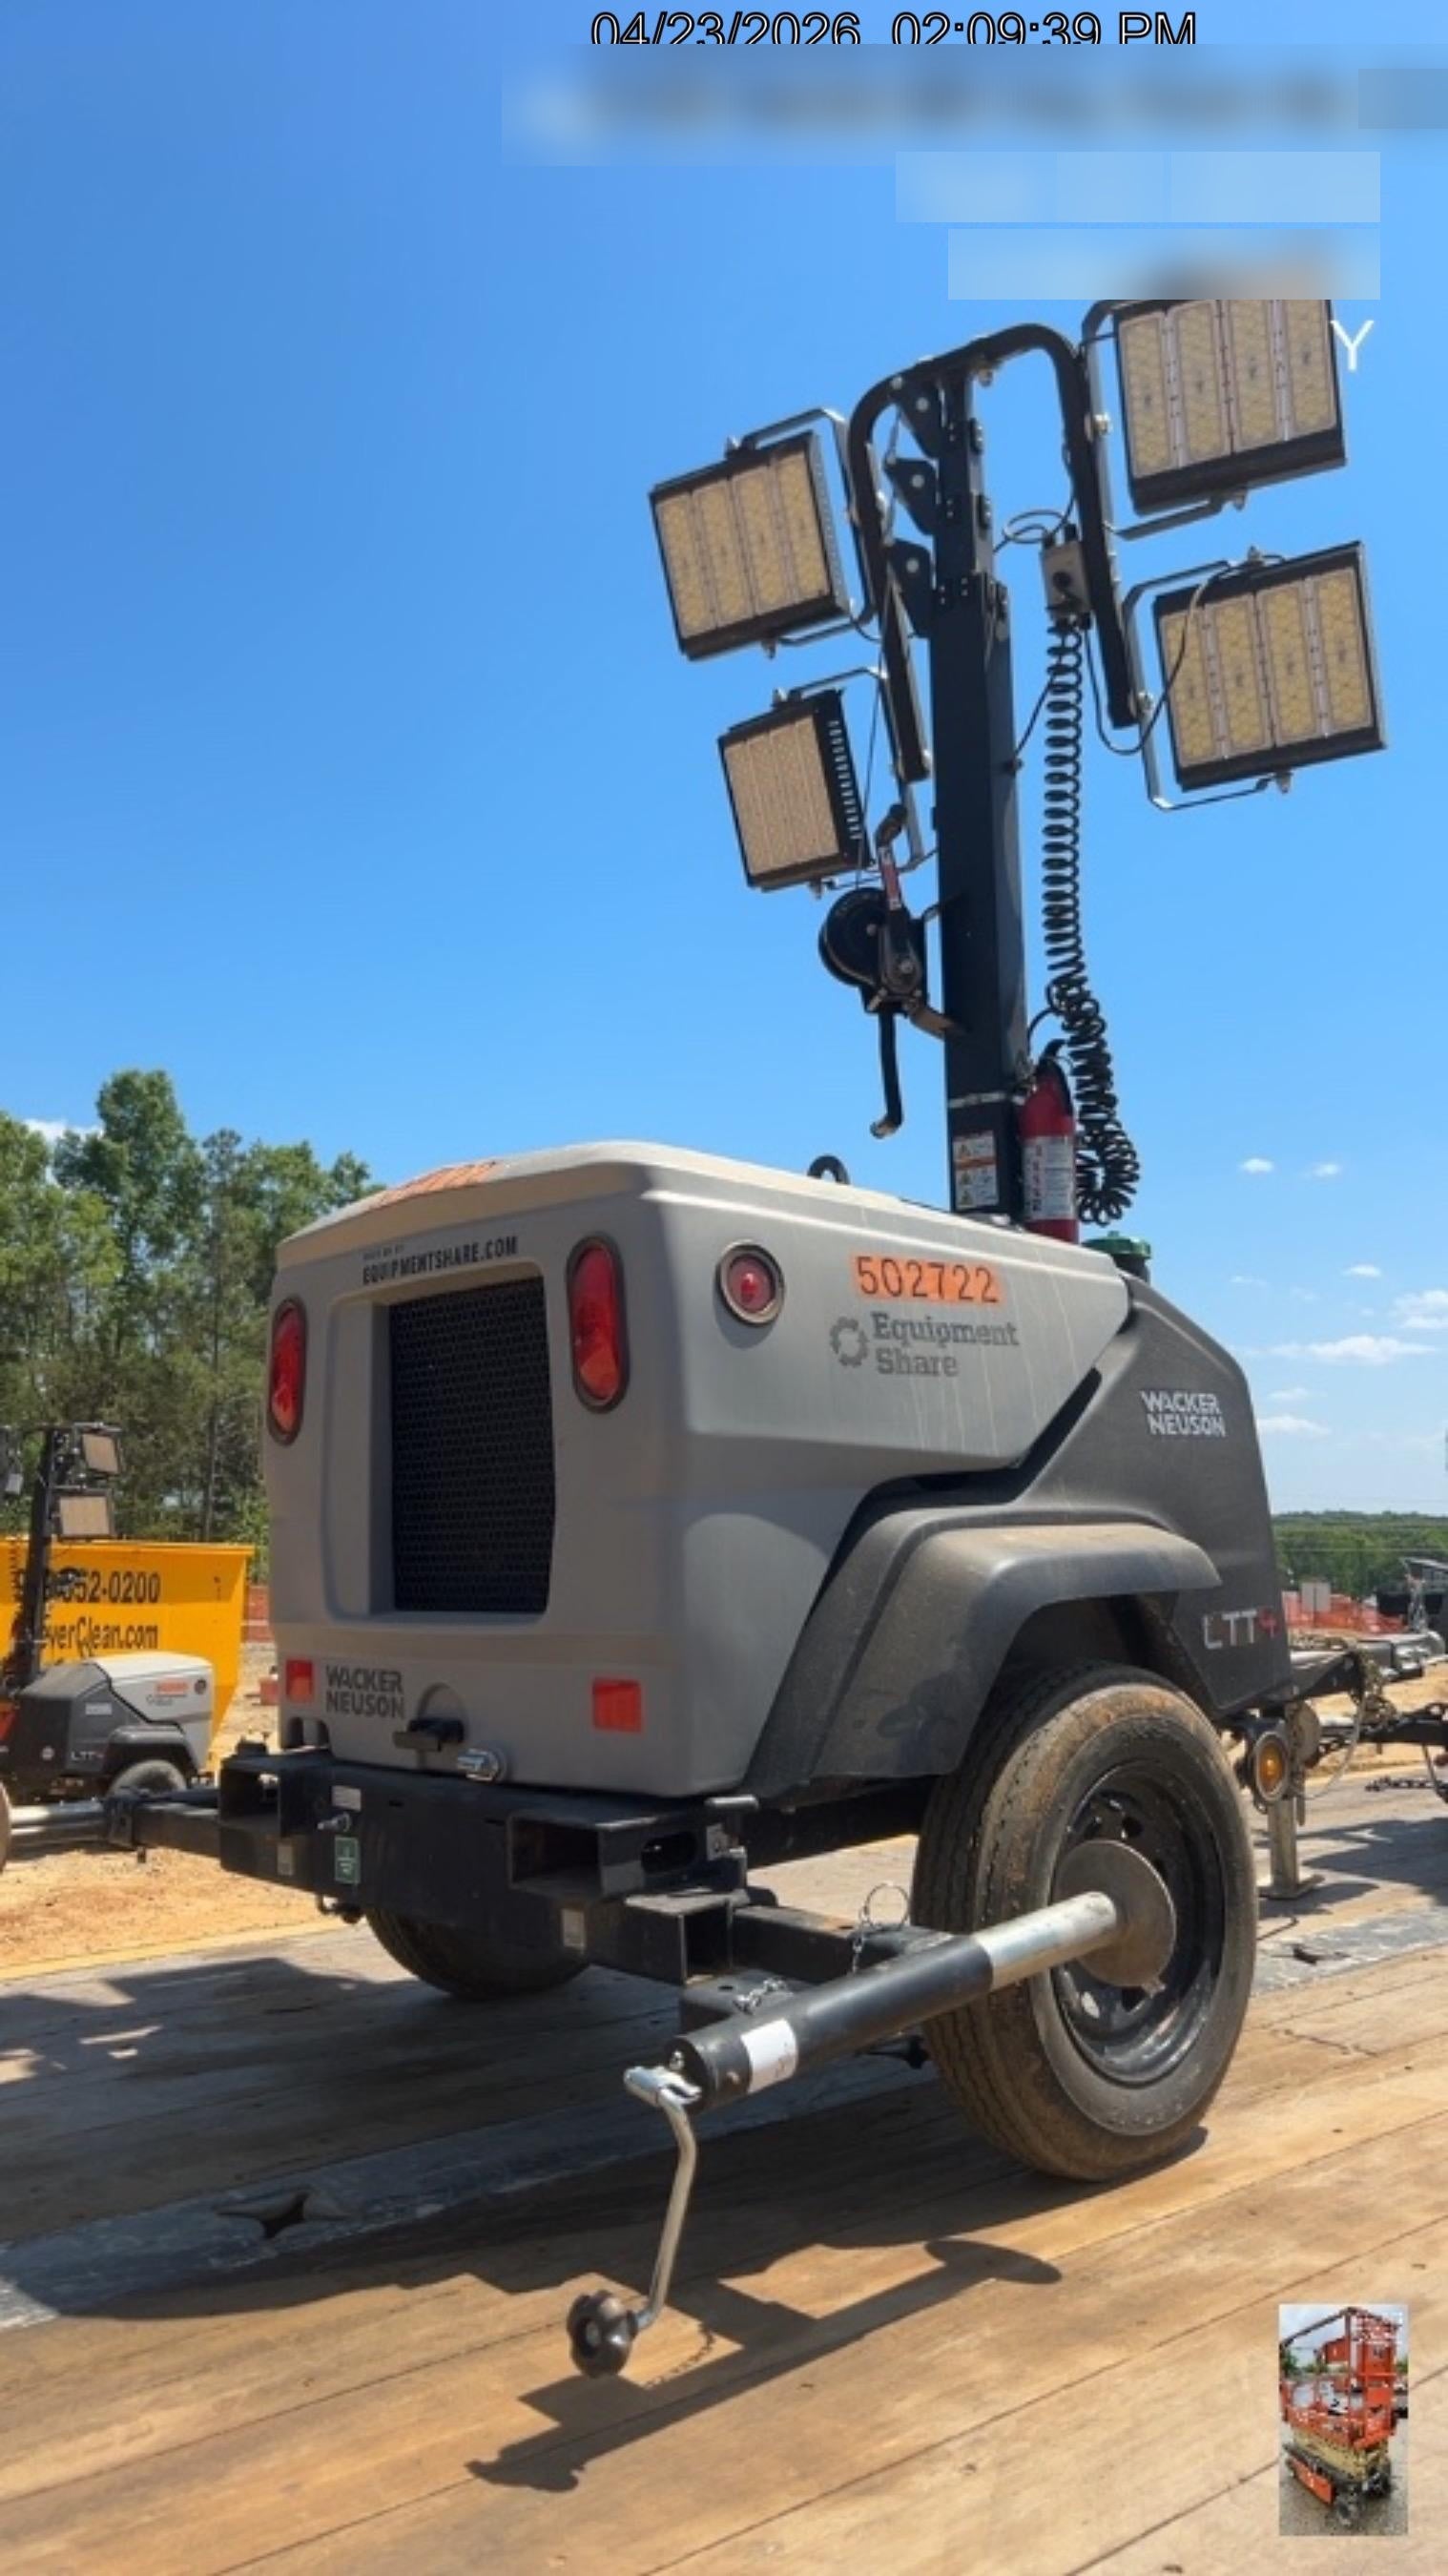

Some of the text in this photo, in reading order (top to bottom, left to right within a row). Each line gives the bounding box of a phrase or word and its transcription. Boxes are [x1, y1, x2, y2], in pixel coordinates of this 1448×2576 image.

[362, 1236, 520, 1285] EQUIPMENTSHARE.COM
[857, 1256, 999, 1304] 502722
[870, 1310, 1020, 1349] Equipment
[875, 1347, 961, 1378] Share
[1139, 1390, 1221, 1414] WACKER
[1147, 1413, 1226, 1438] NEUSON
[325, 1665, 404, 1694] WACKER
[325, 1691, 404, 1720] NEUSON
